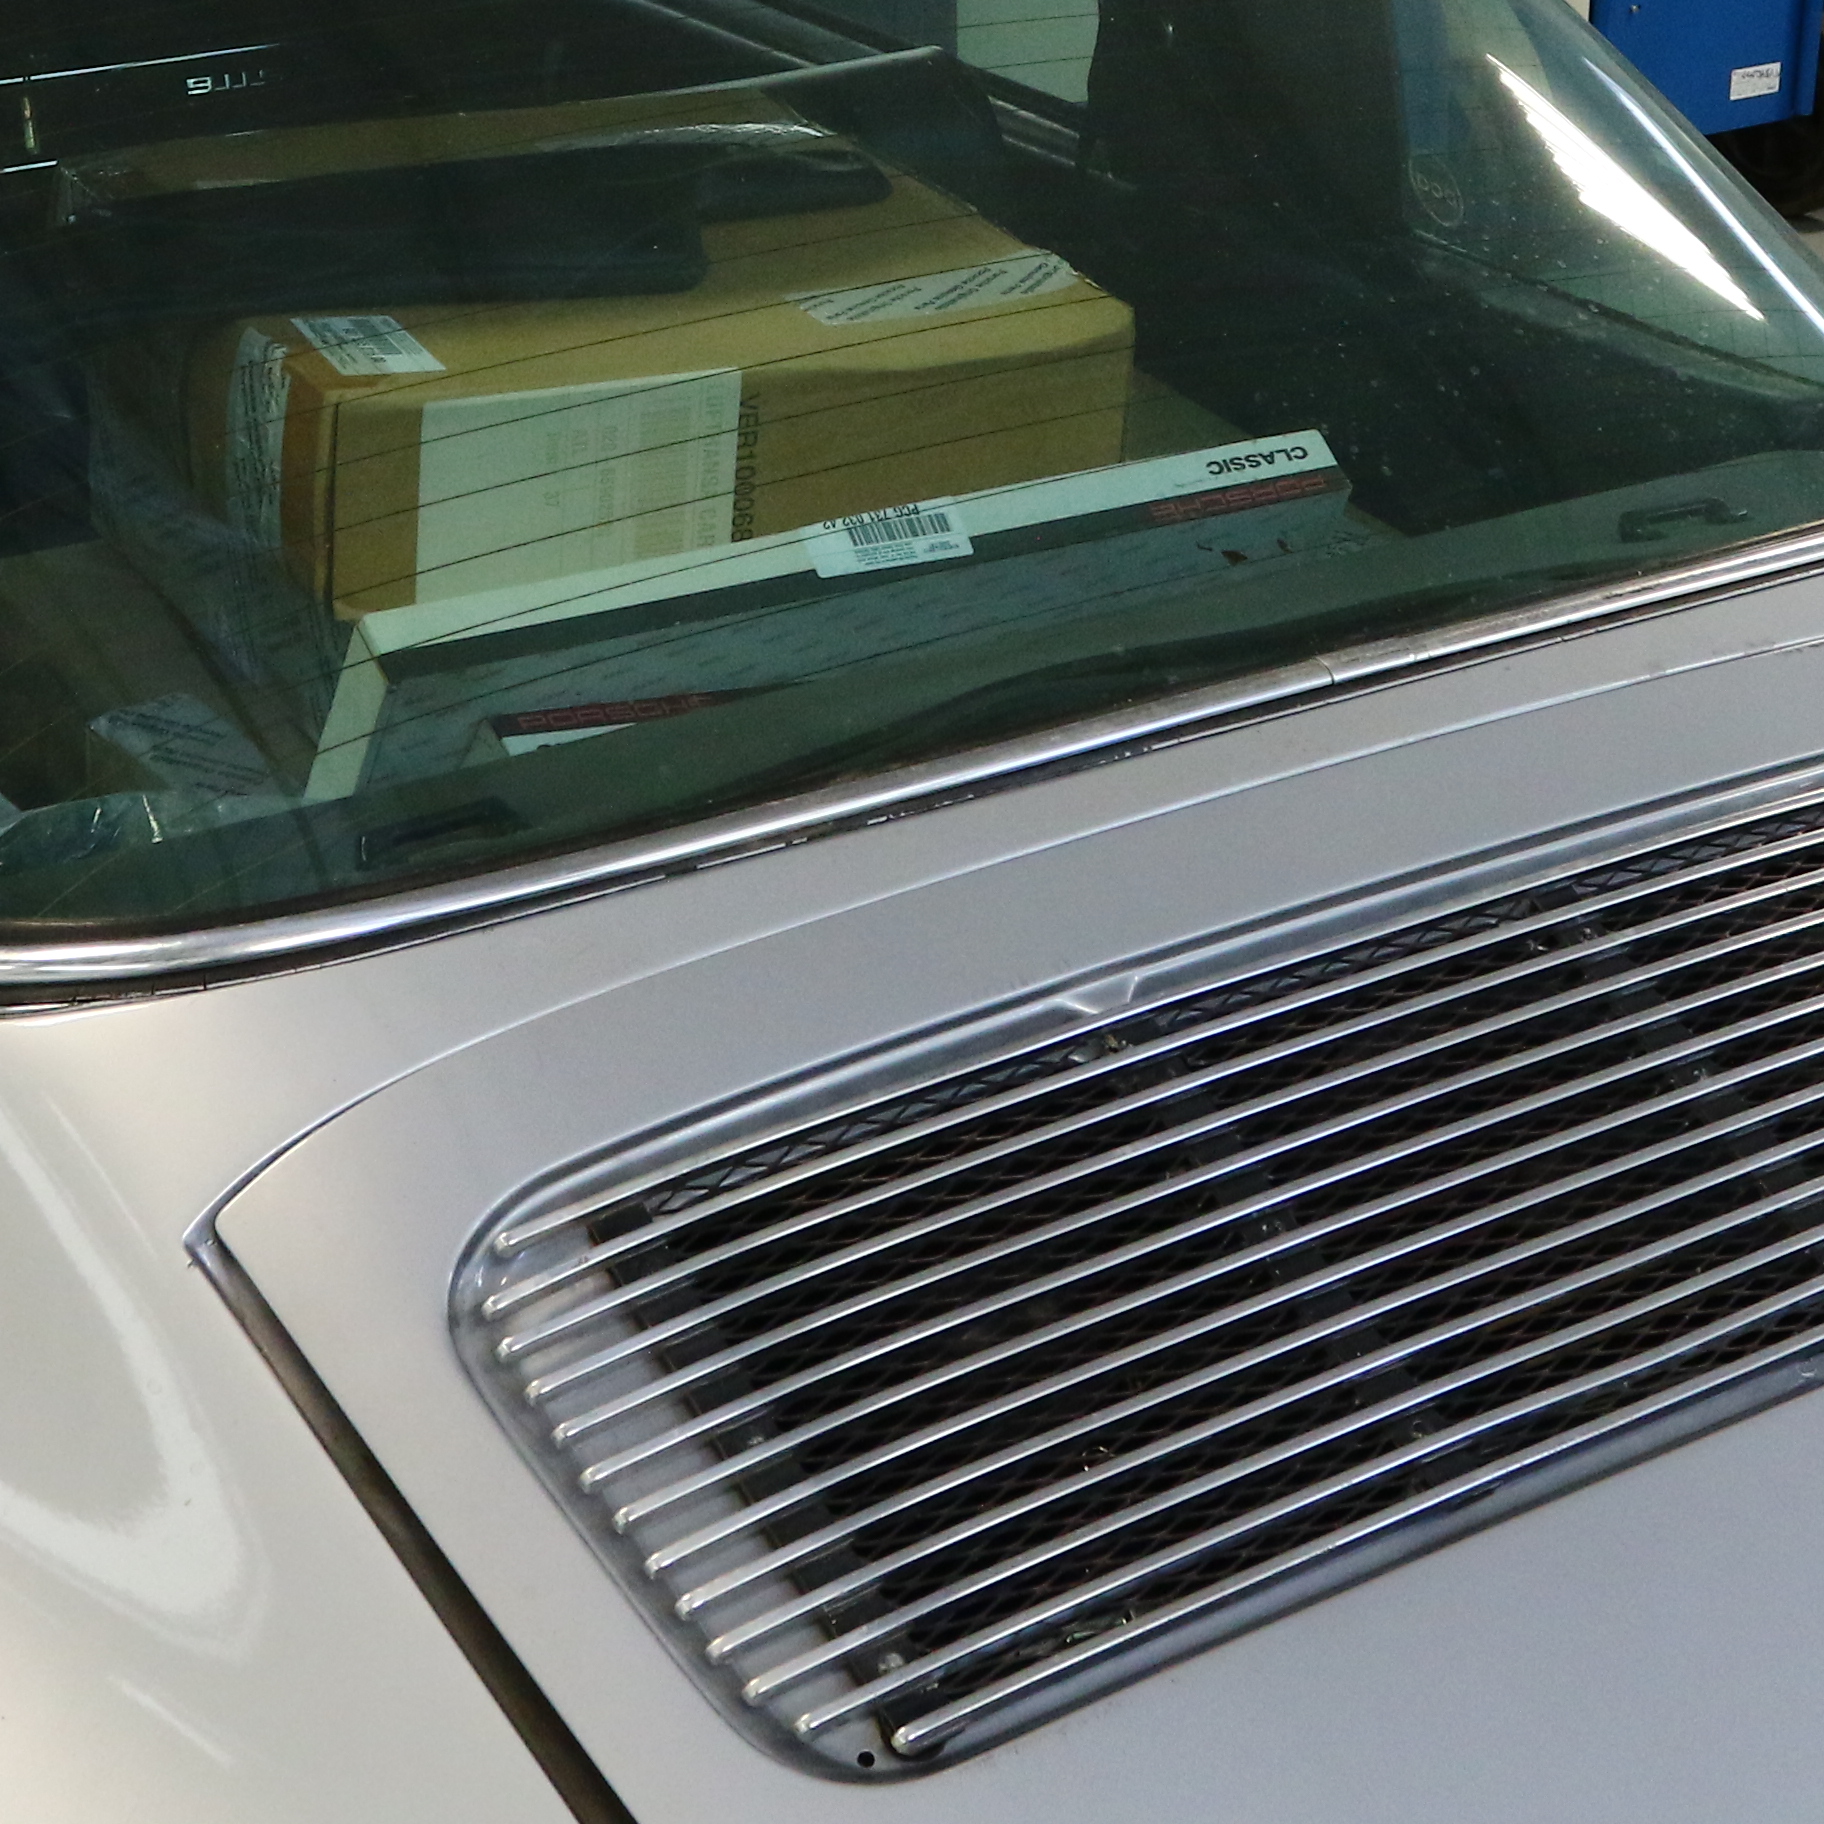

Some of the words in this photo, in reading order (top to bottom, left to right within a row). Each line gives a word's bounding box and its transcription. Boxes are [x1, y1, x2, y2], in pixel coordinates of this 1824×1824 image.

[1206, 445, 1309, 477] CLASSIC
[1150, 475, 1327, 524] PORSCHE
[517, 694, 714, 730] PORSCHE
